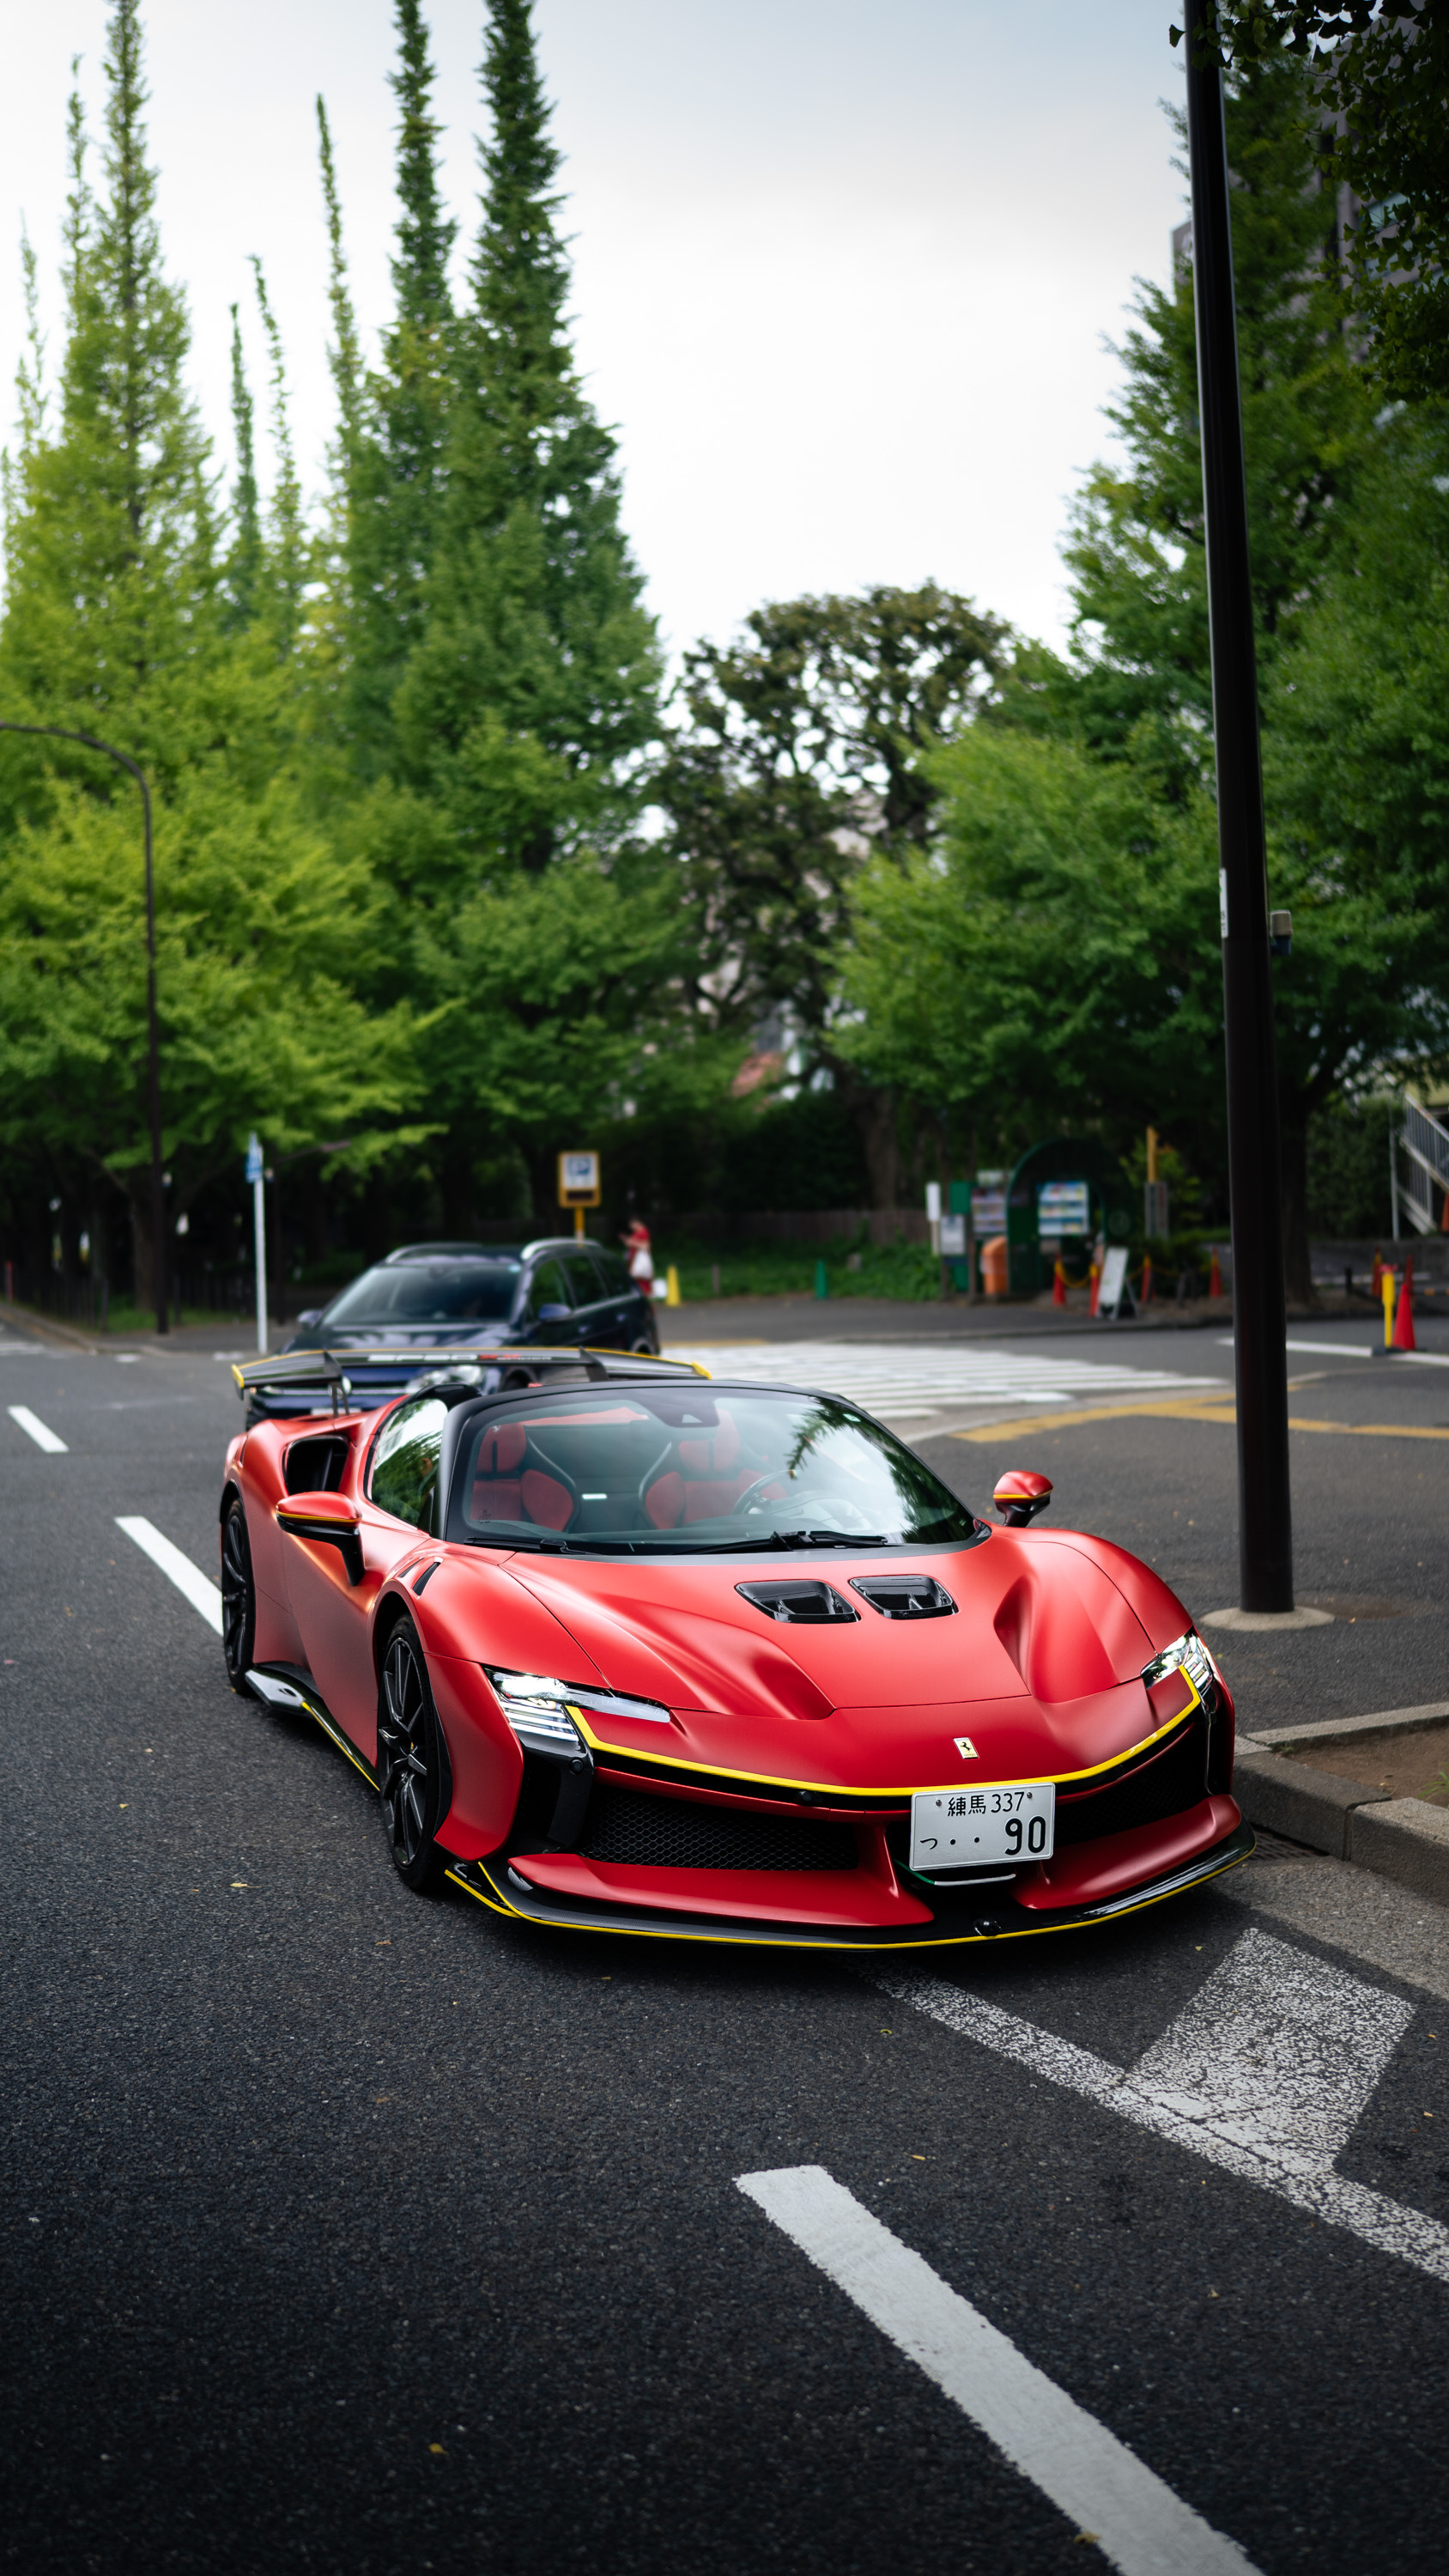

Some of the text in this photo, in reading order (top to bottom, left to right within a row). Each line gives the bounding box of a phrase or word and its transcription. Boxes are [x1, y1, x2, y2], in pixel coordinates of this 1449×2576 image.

[947, 1791, 1025, 1817] 練馬 337
[919, 1838, 938, 1850] つ
[1004, 1815, 1046, 1856] 90
